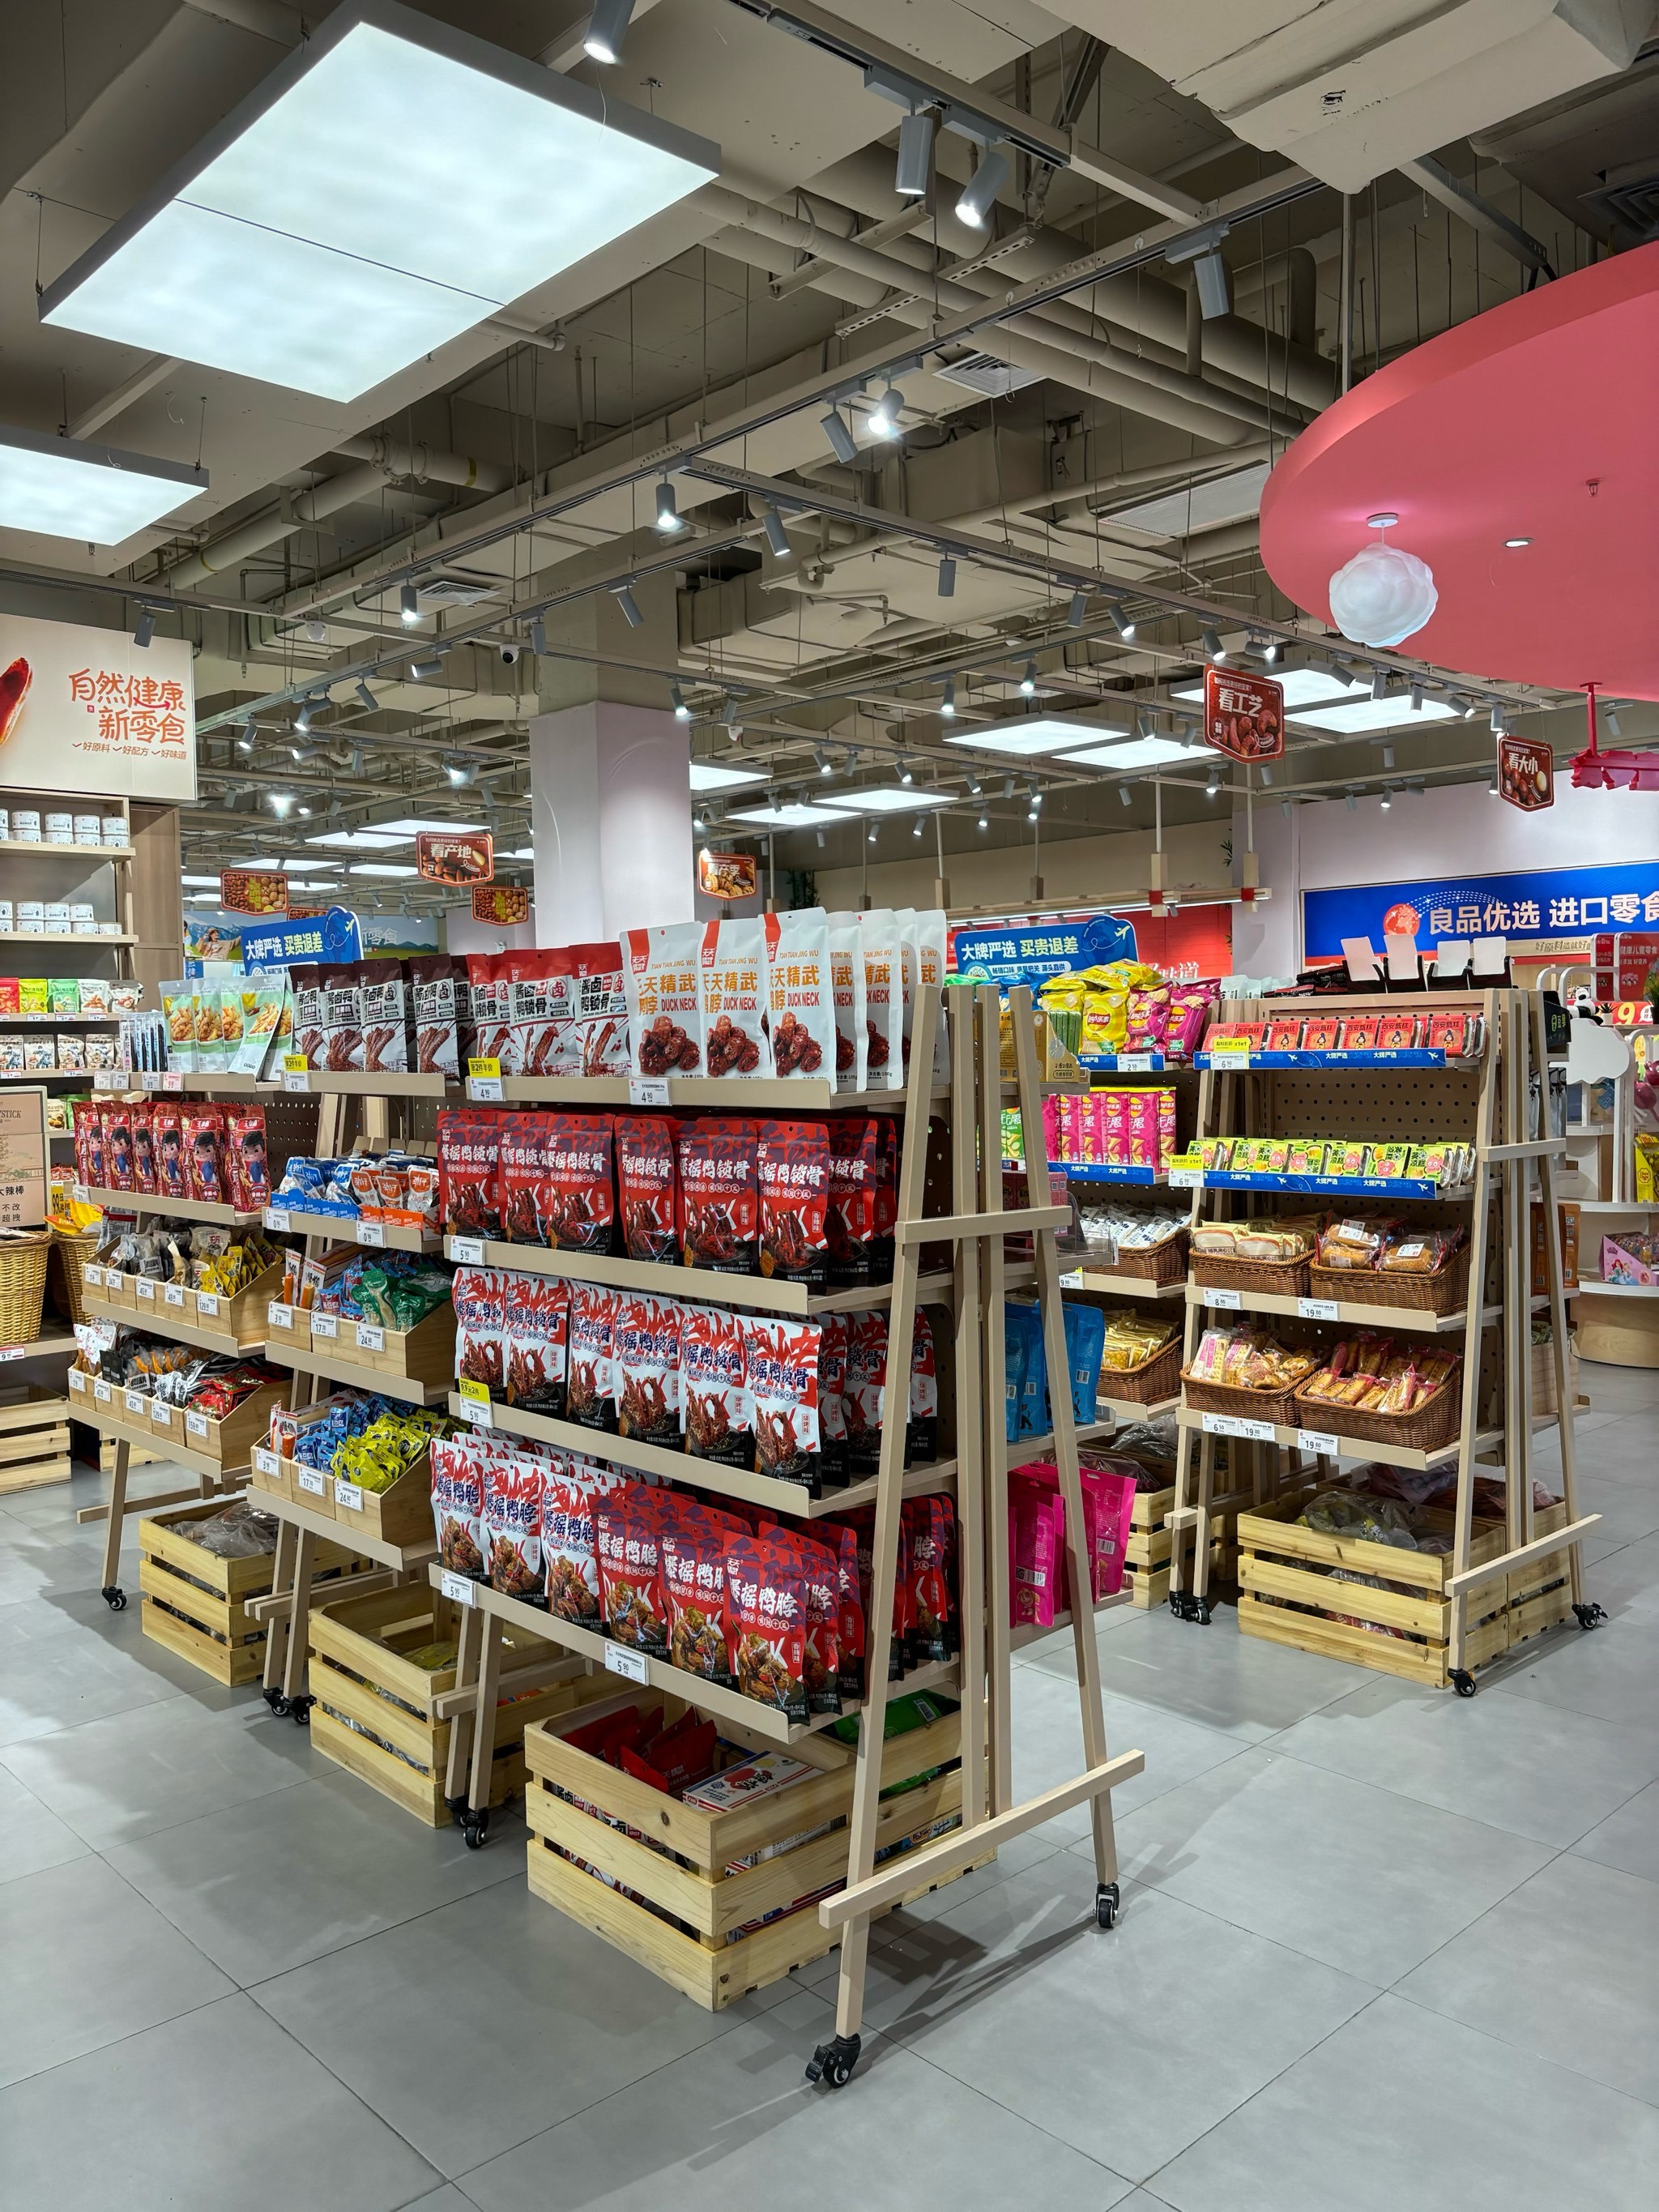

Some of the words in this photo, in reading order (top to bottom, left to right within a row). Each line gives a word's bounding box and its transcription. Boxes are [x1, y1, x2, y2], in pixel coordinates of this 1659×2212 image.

[69, 668, 186, 711] 自然健康
[1218, 687, 1263, 718] 看工艺
[98, 706, 186, 745] 新零食
[83, 741, 110, 753] 好原料
[122, 745, 149, 757] 好配方
[161, 749, 187, 760] 好味道
[1508, 752, 1538, 775] 看大小
[430, 843, 471, 859] 看产地
[1429, 899, 1540, 936] 良品优选
[1549, 890, 1659, 929] 进口零食
[245, 936, 283, 961] 大牌严选
[284, 931, 323, 957] 买贵退差
[962, 941, 1017, 962] 大牌严选
[1020, 935, 1079, 958] 买贵退差
[582, 976, 601, 995] 酱卤
[723, 997, 738, 1011] DUCK
[739, 997, 757, 1010] NECK
[787, 992, 801, 1007] DUCK
[802, 991, 820, 1006] NECK
[837, 992, 853, 1007] NECK
[872, 989, 889, 1003] NECK
[516, 997, 547, 1018] 鸭锁骨
[661, 997, 678, 1012] DUCK
[680, 997, 697, 1010] NECK
[1616, 1002, 1636, 1024] 9
[480, 1088, 484, 1098] 4
[642, 1091, 646, 1103] 4
[460, 1251, 464, 1260] 5
[1306, 1309, 1315, 1317] 19
[361, 1334, 368, 1345] 24
[470, 1410, 473, 1420] 5
[1245, 1428, 1253, 1436] 19
[1305, 1440, 1314, 1449] 19
[485, 1492, 537, 1522] 爆摇鸭脖
[598, 1531, 658, 1566] 爆摇鸭脖
[450, 1586, 454, 1595] 5
[617, 1660, 622, 1672] 5
[623, 1663, 629, 1672] 90
